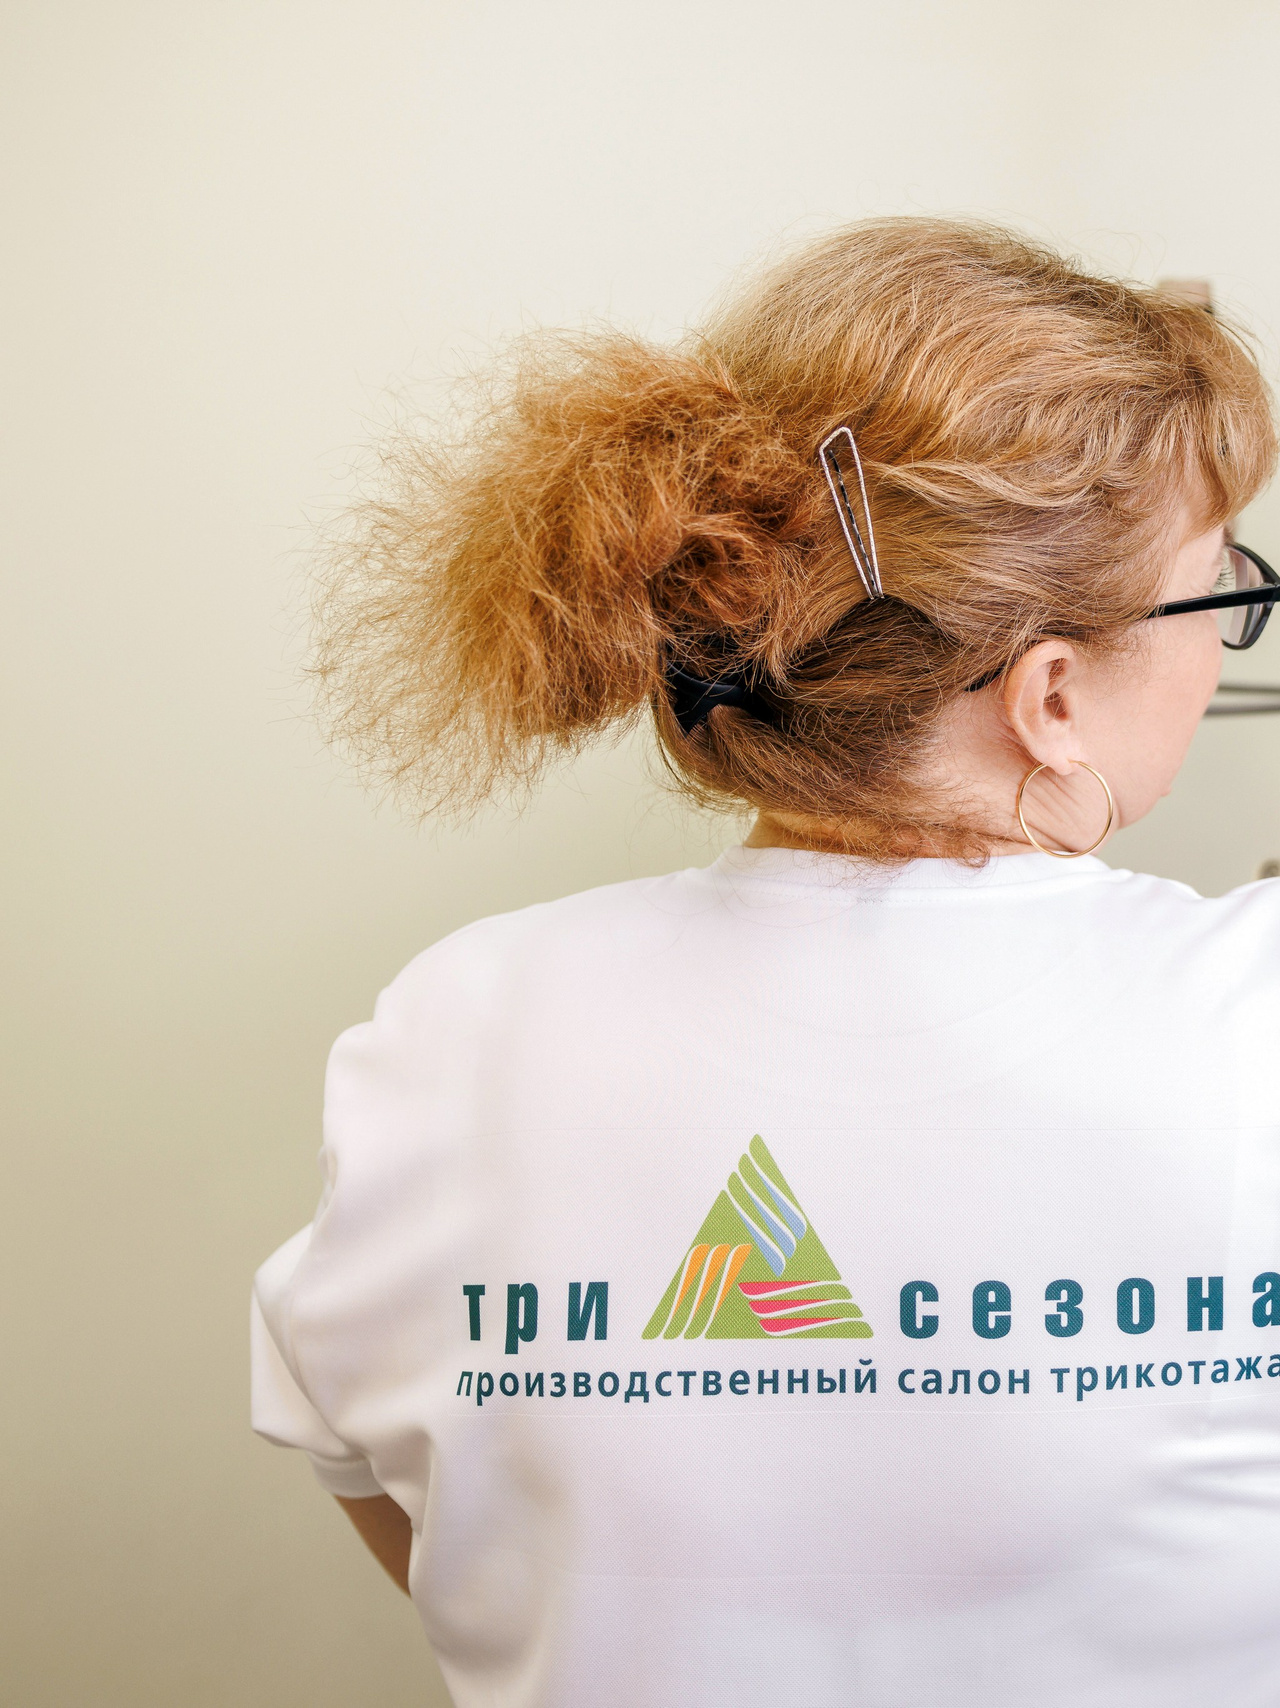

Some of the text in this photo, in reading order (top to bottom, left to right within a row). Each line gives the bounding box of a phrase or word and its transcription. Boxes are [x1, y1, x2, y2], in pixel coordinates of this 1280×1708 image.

[462, 1282, 609, 1355] три
[456, 1358, 877, 1407] производственный
[897, 1368, 1030, 1395] салон
